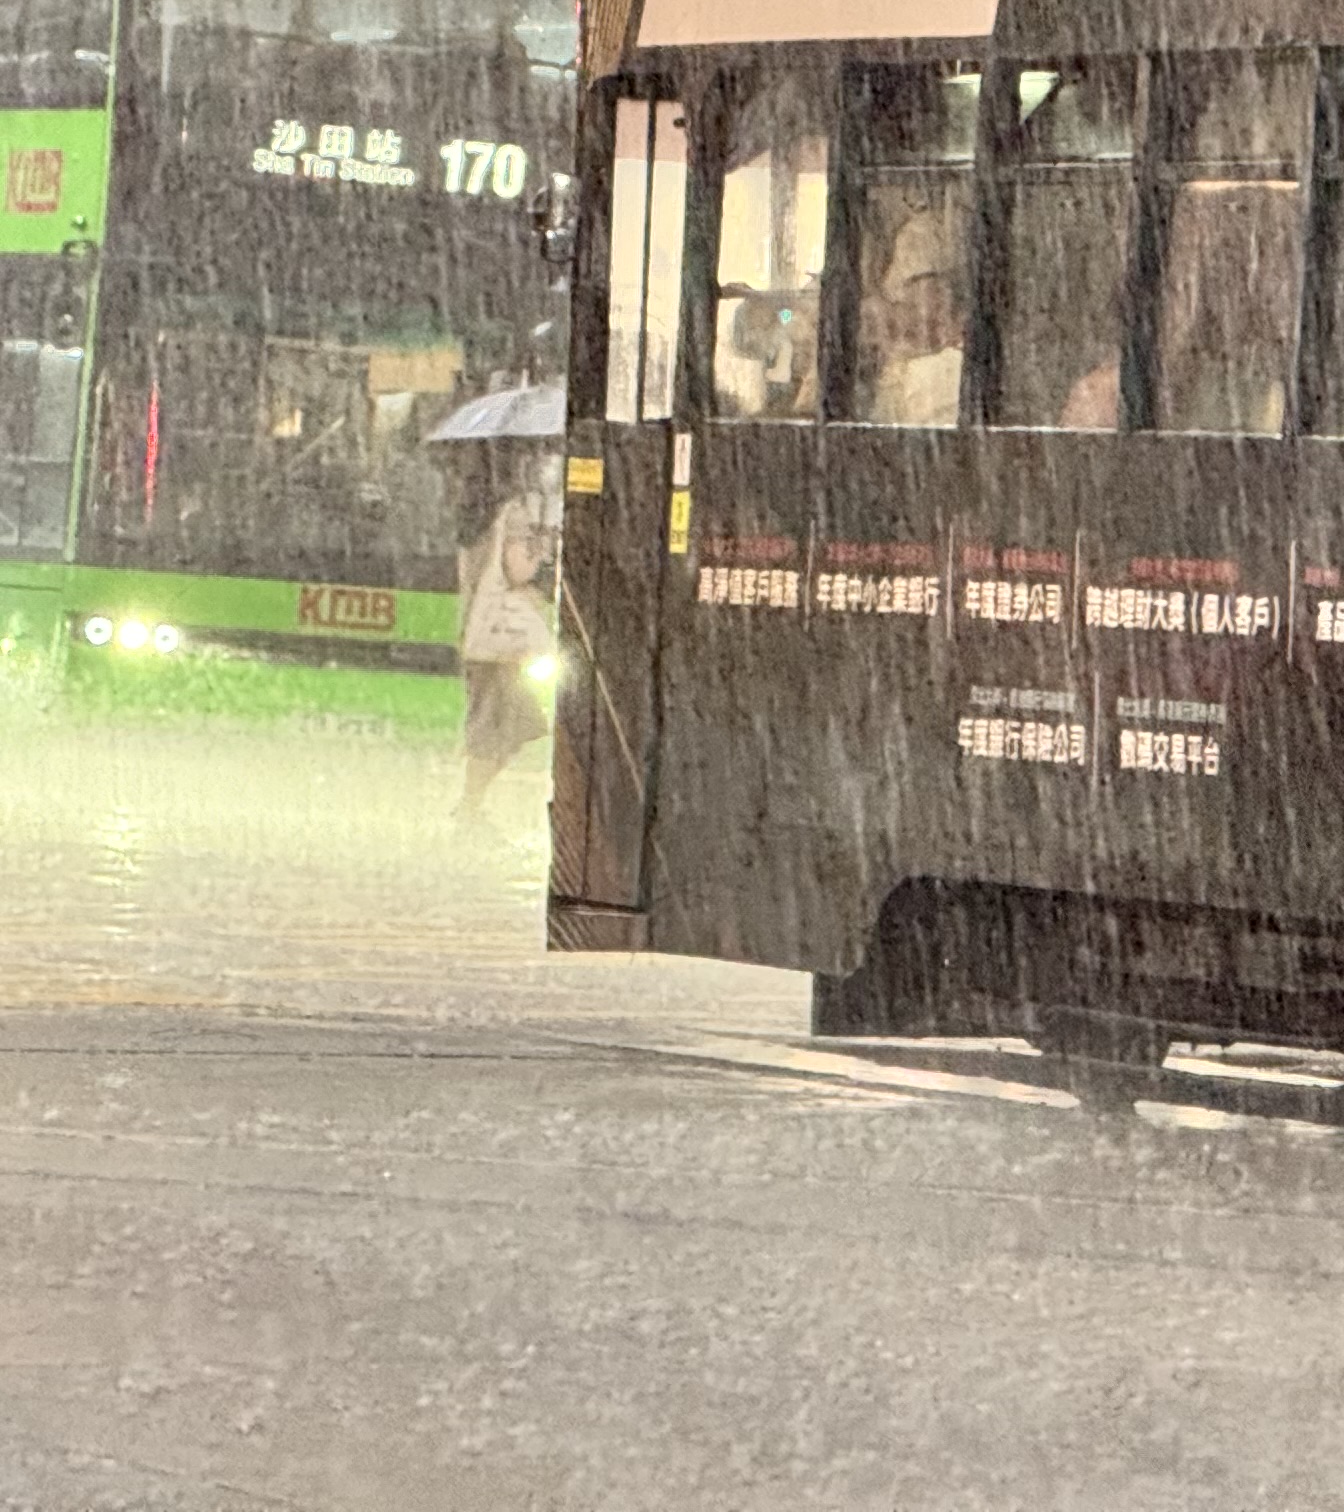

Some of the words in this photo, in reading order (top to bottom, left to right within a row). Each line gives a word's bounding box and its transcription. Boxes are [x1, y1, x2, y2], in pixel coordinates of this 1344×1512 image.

[271, 119, 402, 165] 沙田站
[440, 139, 527, 199] 170
